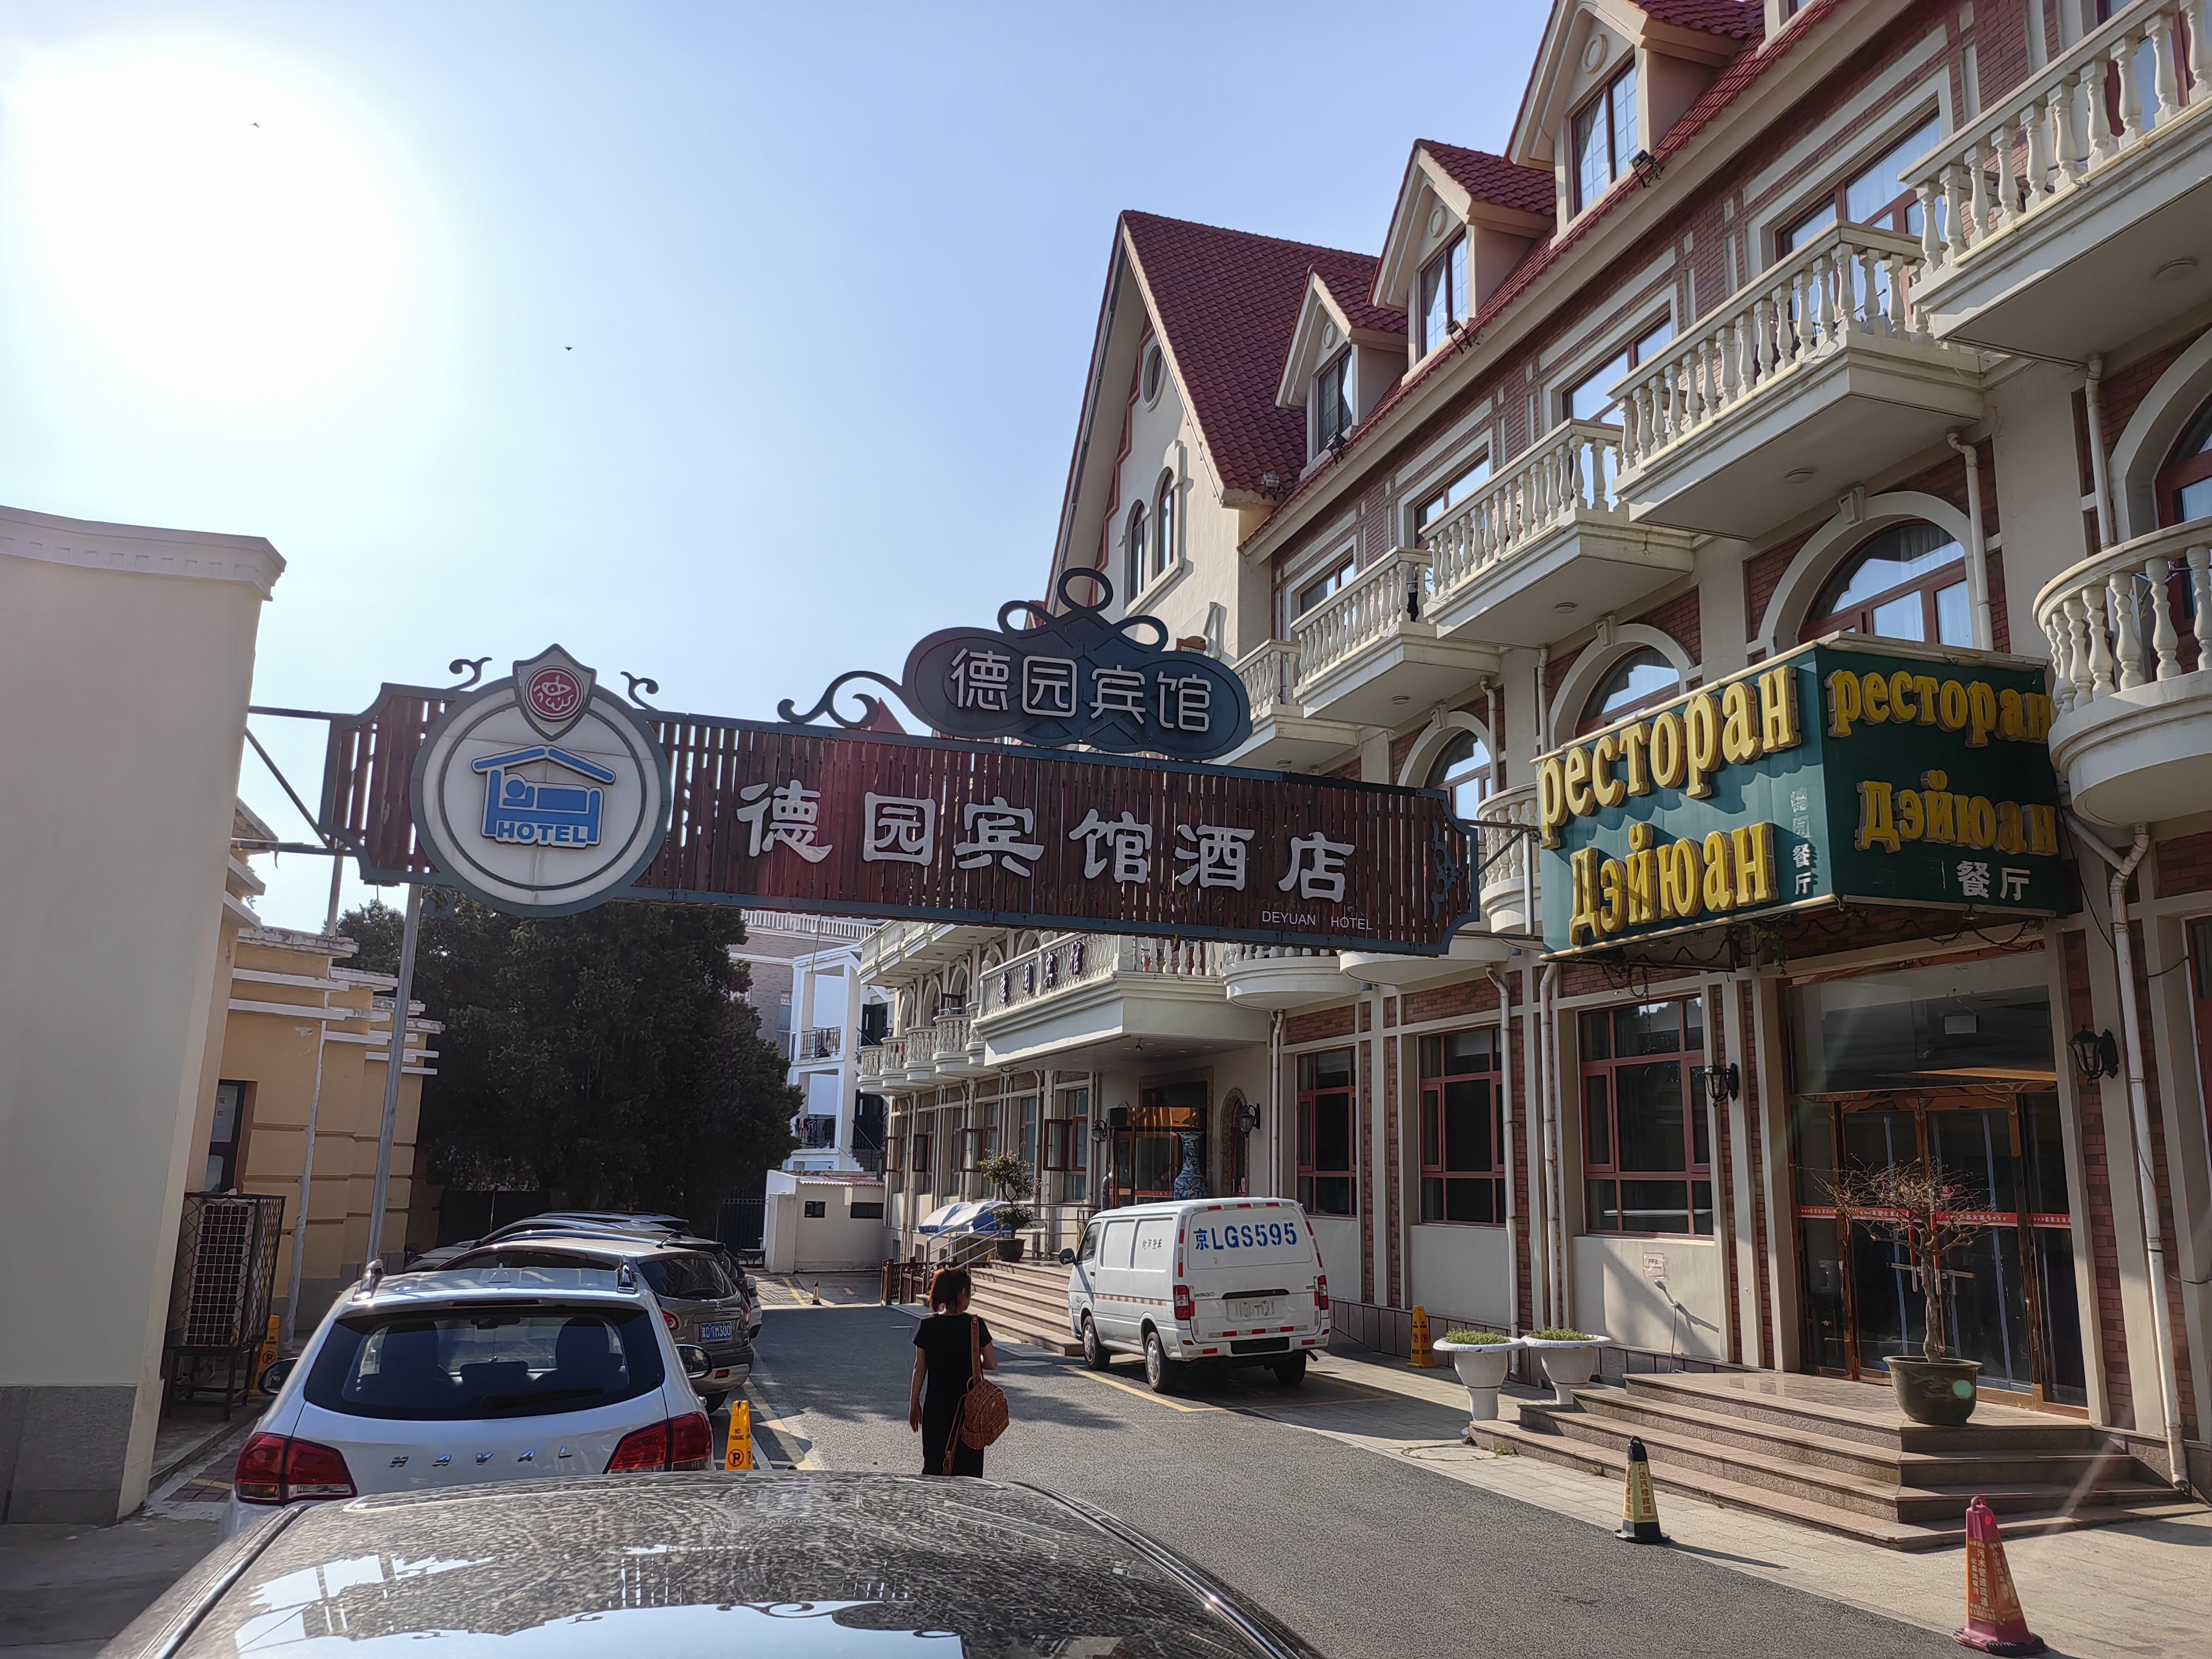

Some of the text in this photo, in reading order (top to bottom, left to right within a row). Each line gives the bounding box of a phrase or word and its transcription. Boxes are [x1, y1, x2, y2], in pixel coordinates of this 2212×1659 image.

[950, 647, 1212, 732] 德园宾馆
[1826, 668, 2051, 748] ресторан
[1537, 665, 1801, 850] ресторан
[497, 821, 588, 843] HOTEL
[737, 779, 1356, 903] 德园宾馆酒店
[1957, 860, 2030, 901] 餐厅
[1262, 911, 1373, 930] DEYUAN HOTEL
[1193, 1222, 1297, 1250] 京LGS595
[389, 1446, 572, 1467] HAVAL
